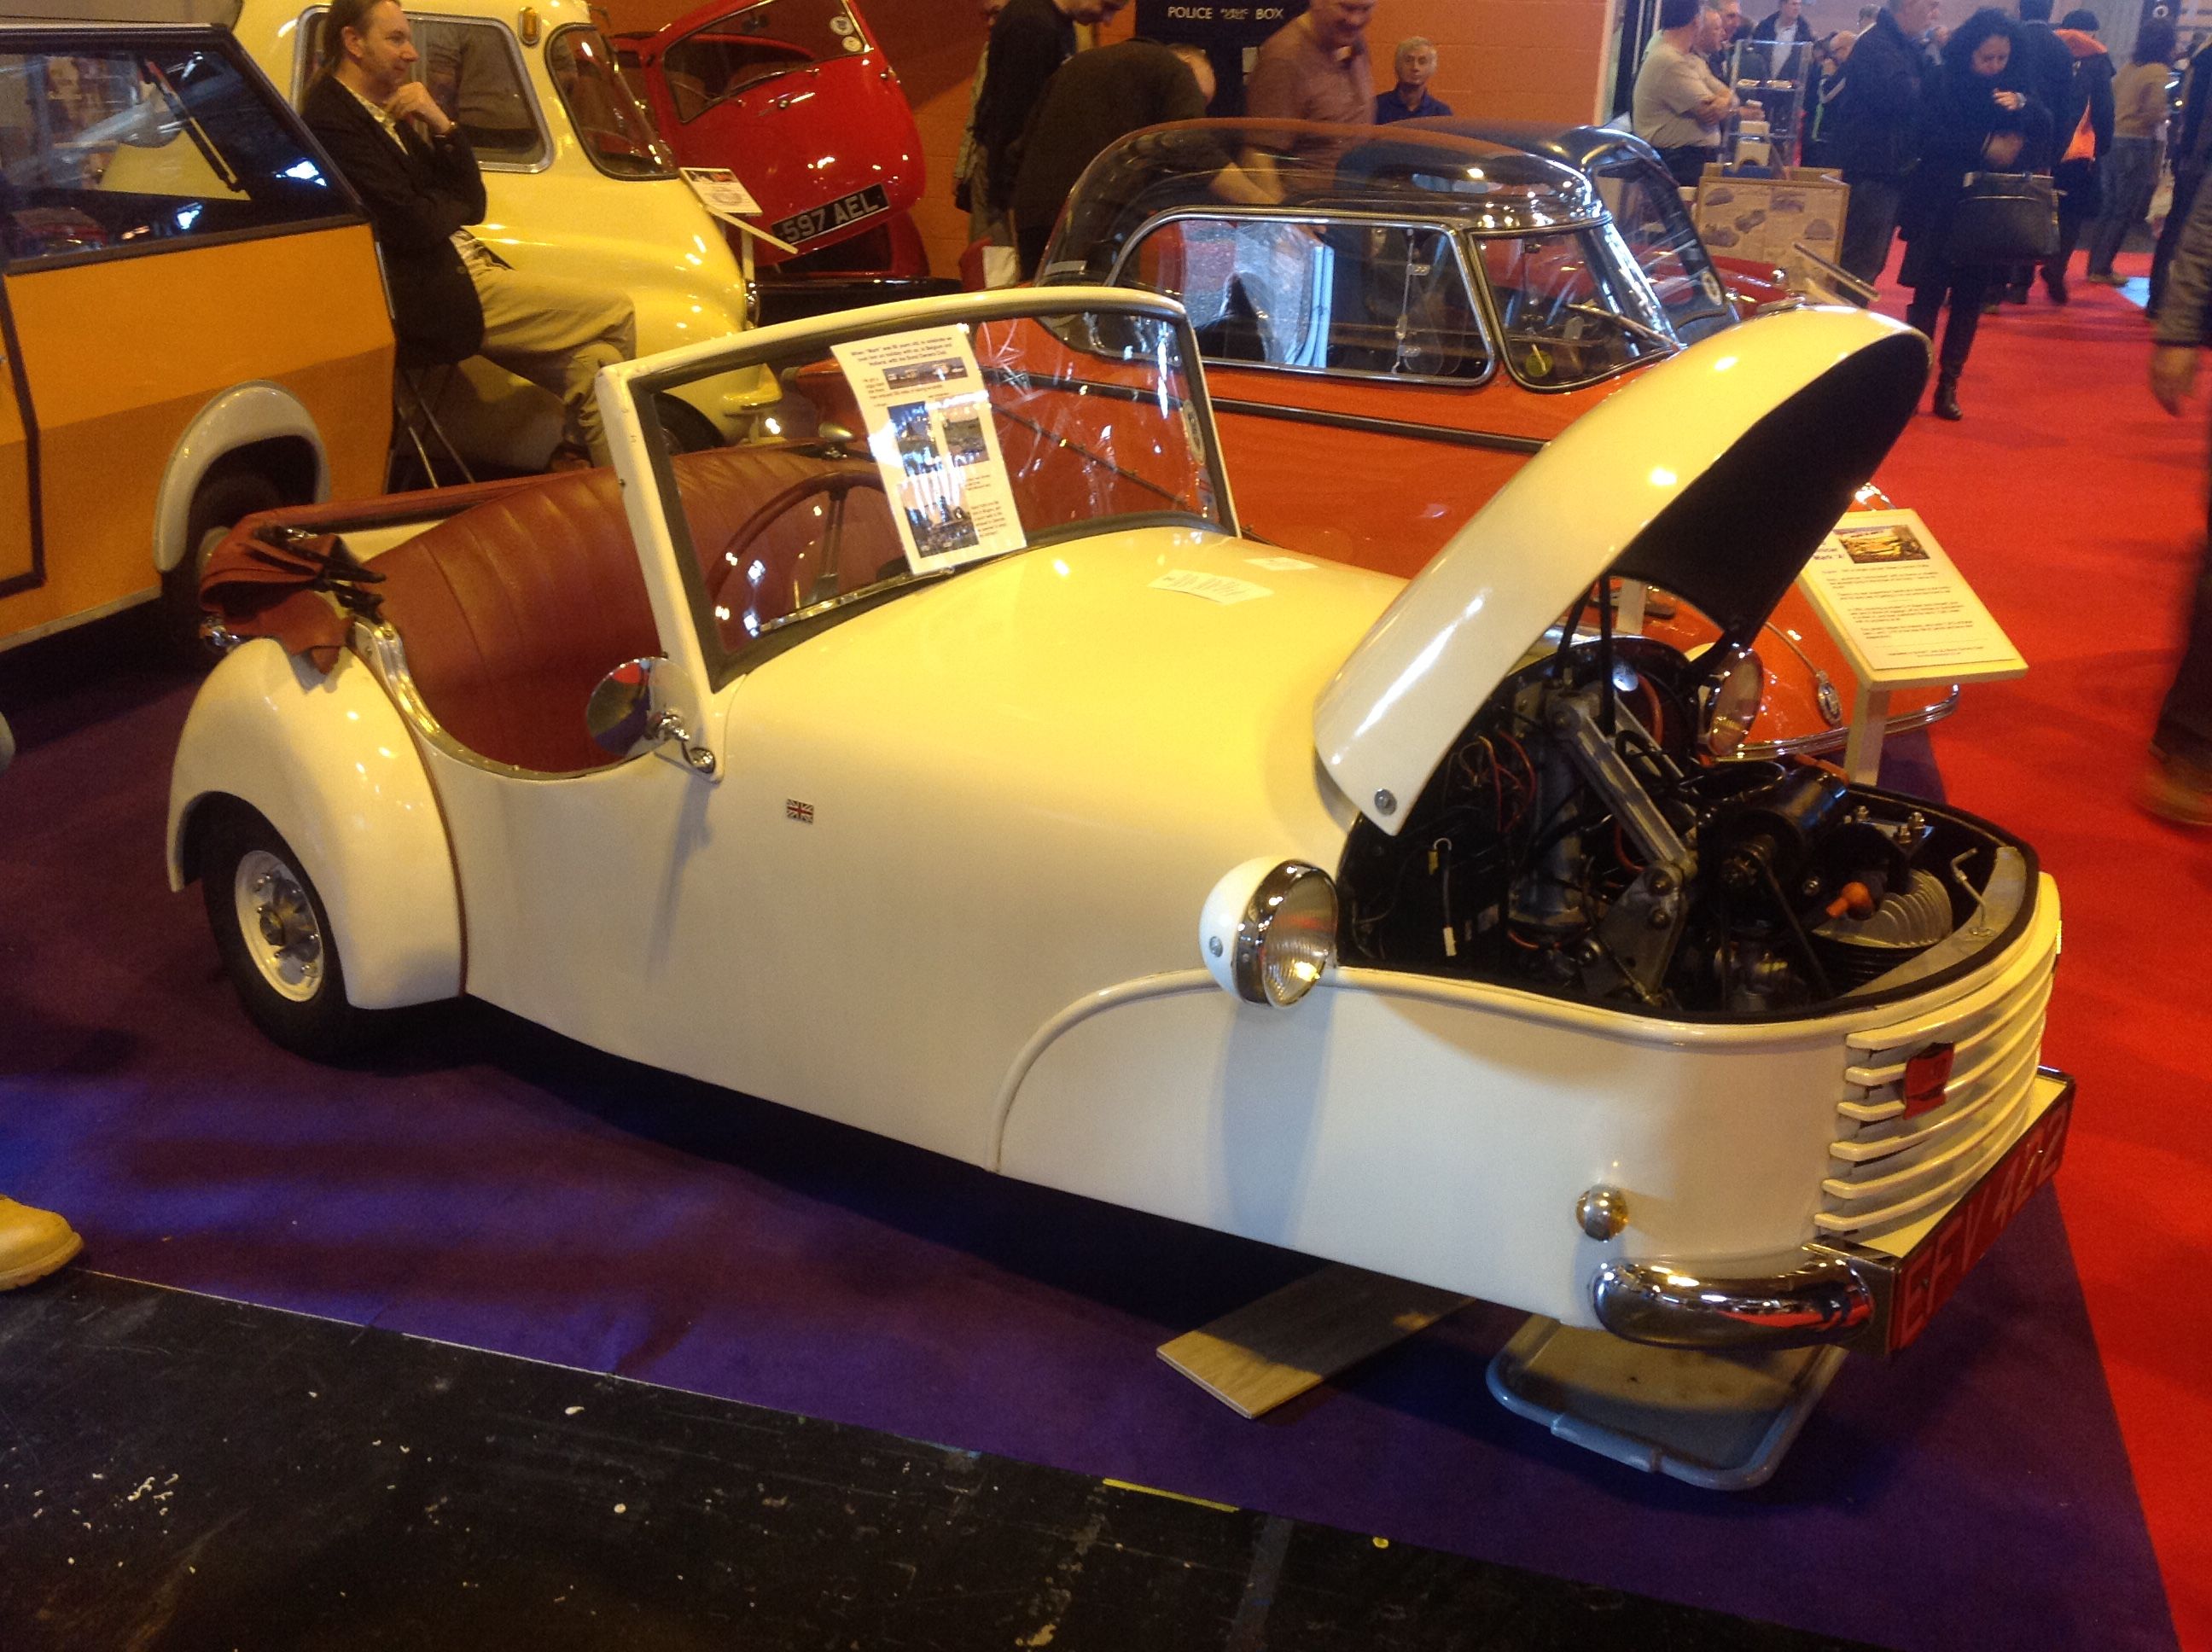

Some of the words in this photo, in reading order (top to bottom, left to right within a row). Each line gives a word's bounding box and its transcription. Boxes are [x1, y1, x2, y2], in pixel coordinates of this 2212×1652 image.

[1167, 7, 1213, 20] POLICE
[1255, 8, 1284, 20] BOX
[782, 212, 826, 241] 597
[835, 191, 879, 225] AEL
[1900, 1186, 1989, 1350] EFV
[1993, 1106, 2068, 1230] 422
